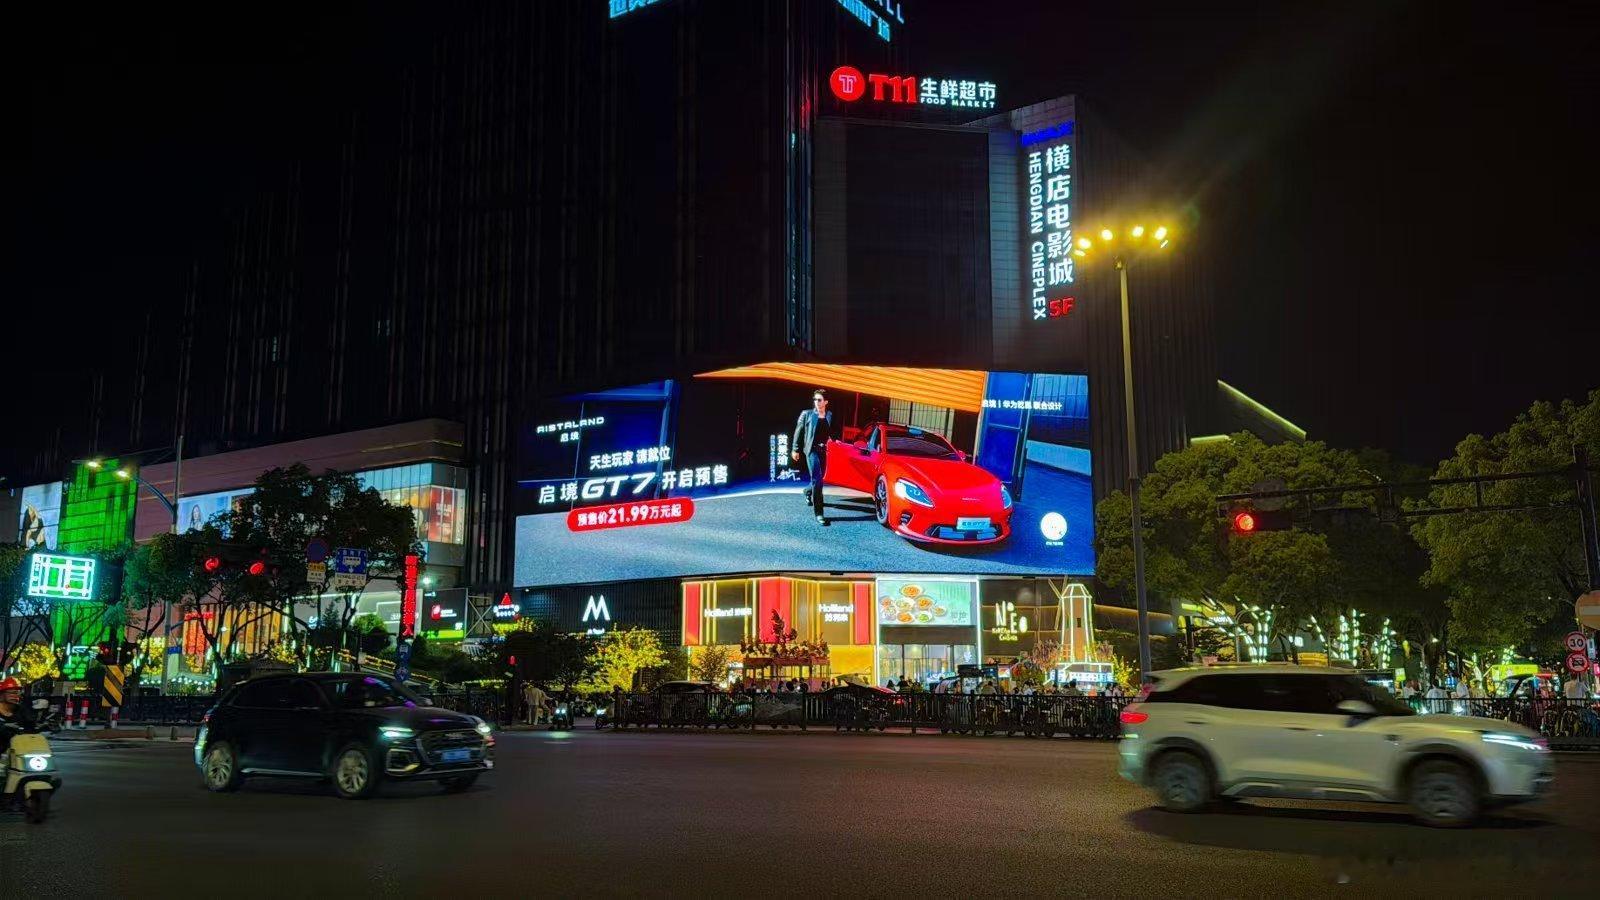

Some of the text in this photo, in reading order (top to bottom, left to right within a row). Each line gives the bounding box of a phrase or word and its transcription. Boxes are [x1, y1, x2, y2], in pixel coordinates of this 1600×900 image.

[869, 73, 917, 104] T11
[920, 78, 996, 101] 生鲜超市
[952, 100, 995, 108] MARKET
[1045, 144, 1074, 286] 横店电影城
[1028, 152, 1047, 320] HENGDIAN CINEPLEX
[1048, 297, 1075, 317] 5F
[590, 446, 670, 470] 天生玩家 请就位
[538, 464, 729, 504] 启境 GT7 开启预售
[578, 503, 682, 527] 预售价21.99万元起
[1570, 638, 1584, 648] 30
